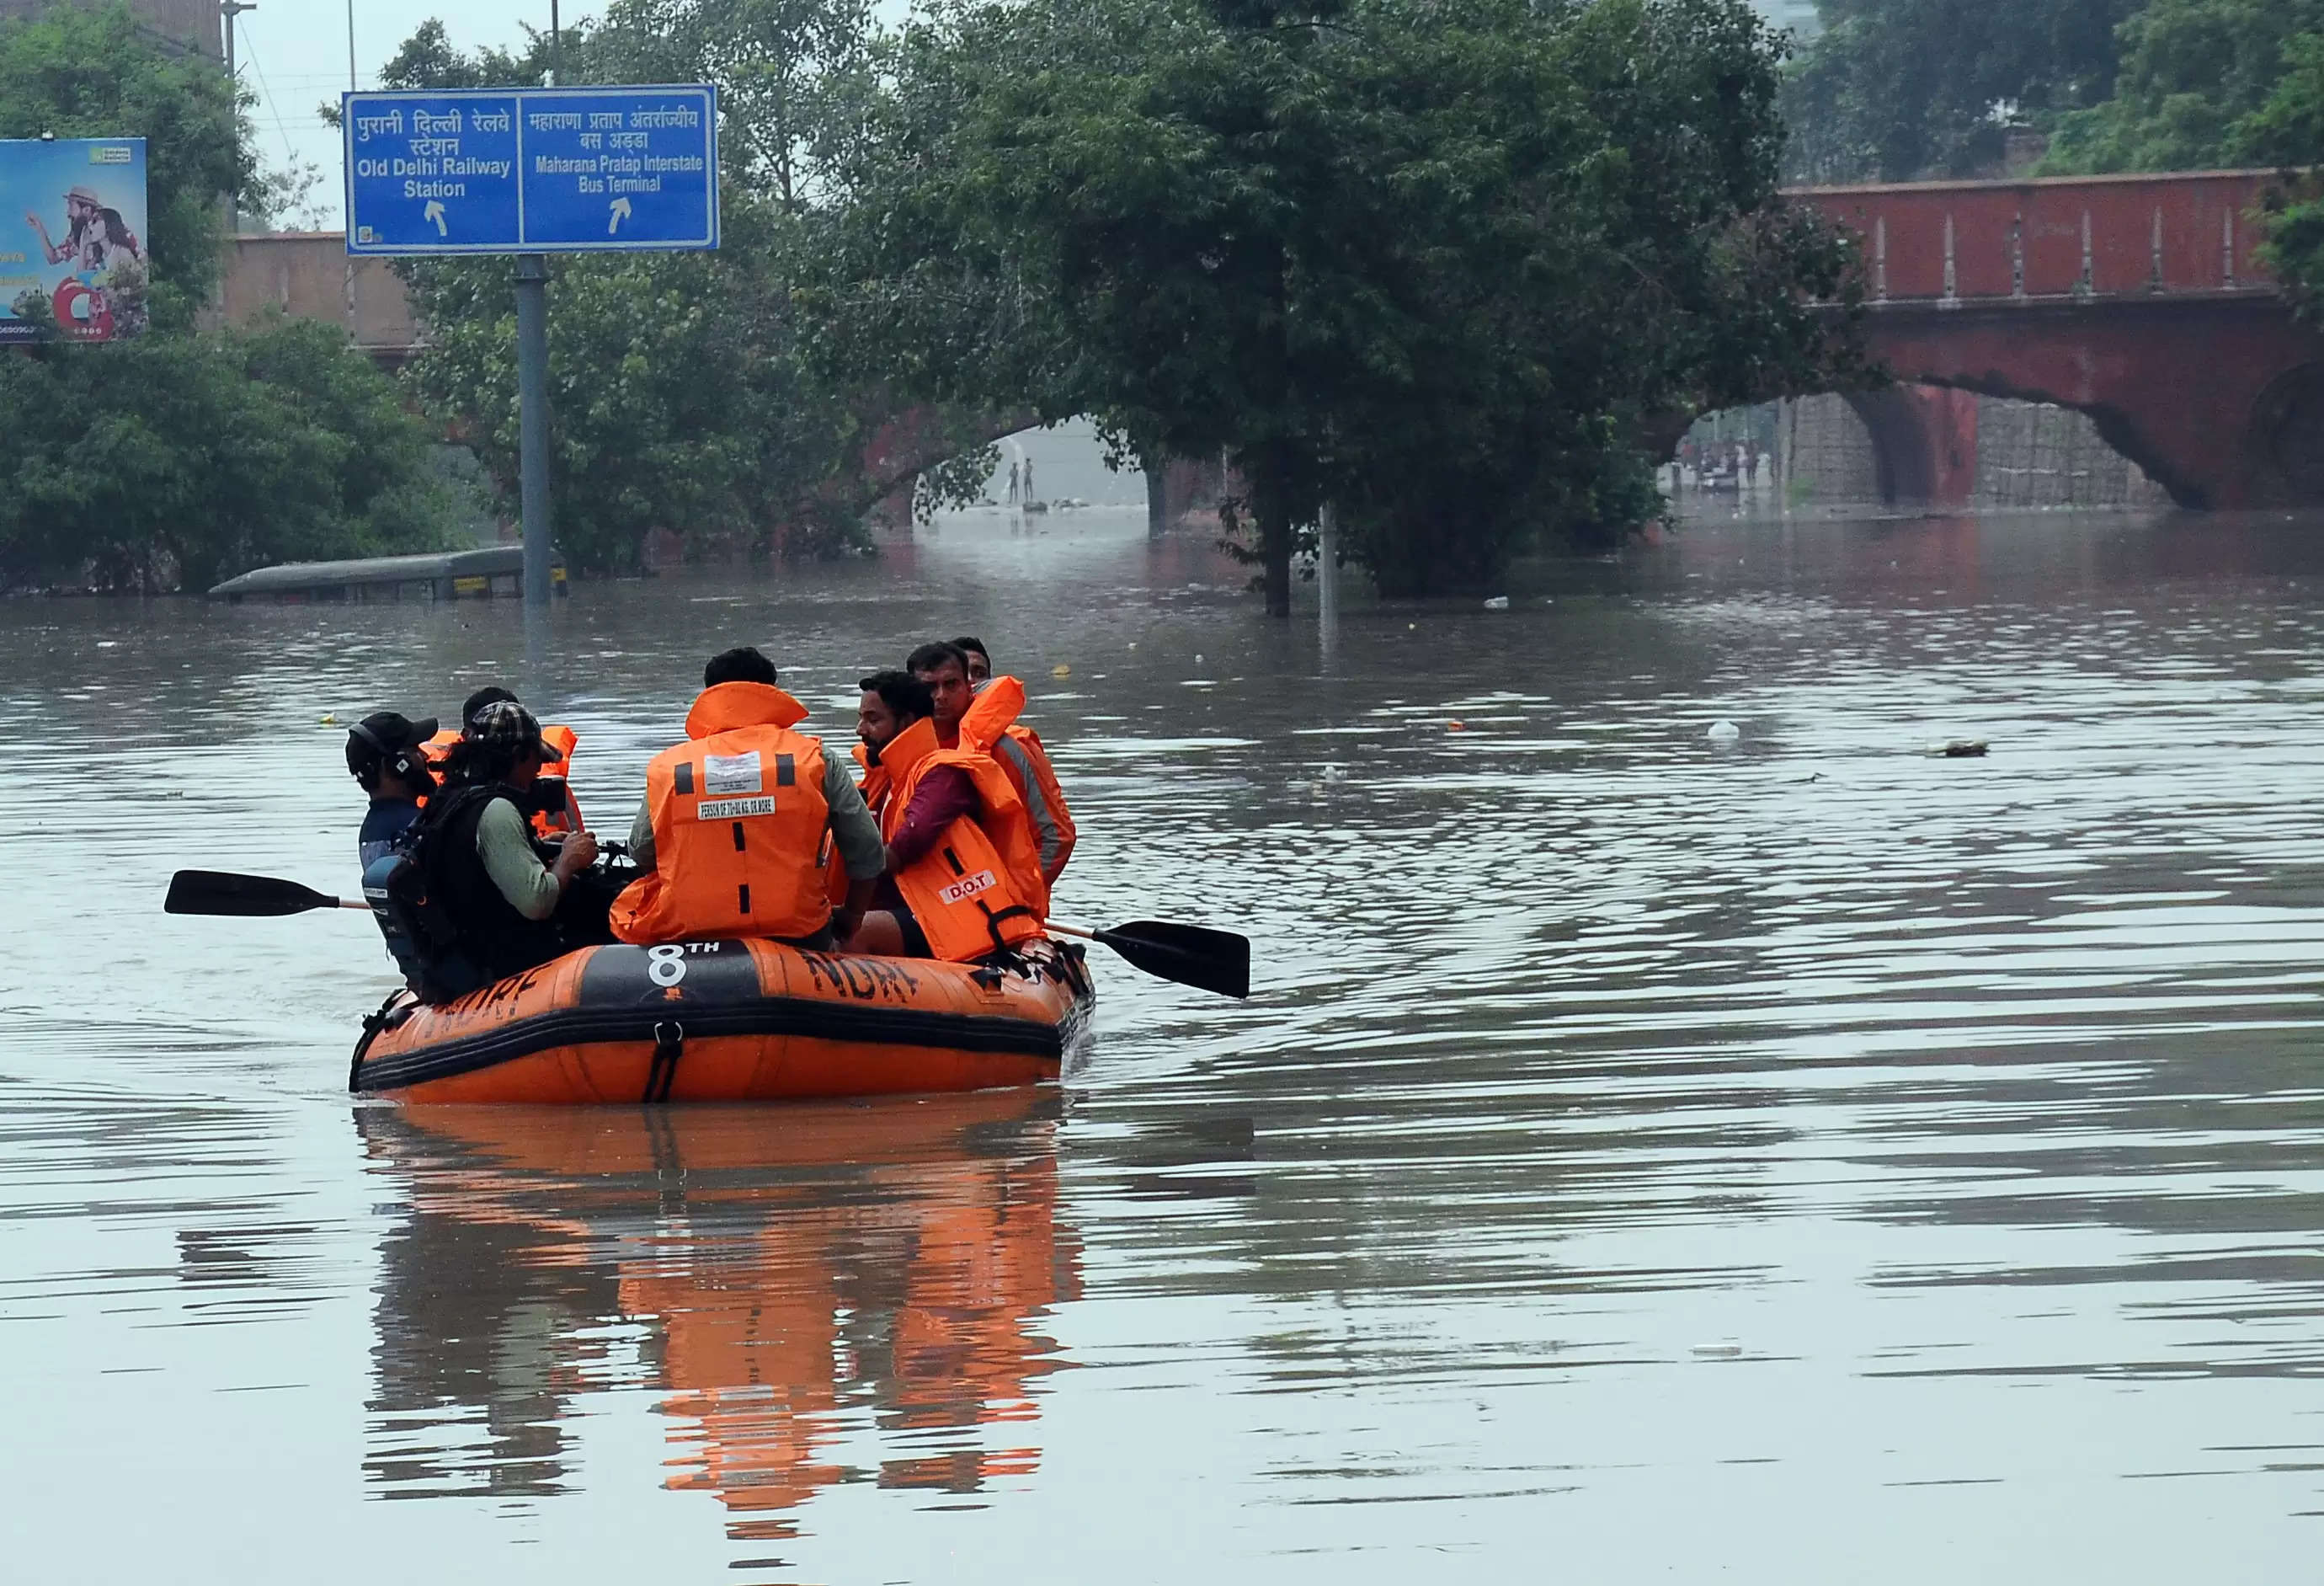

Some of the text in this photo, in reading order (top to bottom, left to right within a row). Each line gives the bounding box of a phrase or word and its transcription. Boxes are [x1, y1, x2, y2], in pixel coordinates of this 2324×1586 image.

[356, 108, 510, 142] पुरानी दिल्ली रेलवे
[529, 112, 582, 132] महाराणा
[589, 112, 623, 130] प्रताप
[408, 133, 460, 156] स्टेशन
[579, 131, 602, 149] बस
[357, 157, 511, 179] Old Delhi Railway
[536, 154, 703, 175] Maharana Pratap Interstate
[404, 179, 466, 198] Station
[578, 174, 661, 193] Bus Terminal
[701, 803, 720, 818] PERSON
[950, 874, 986, 900] D.O.T
